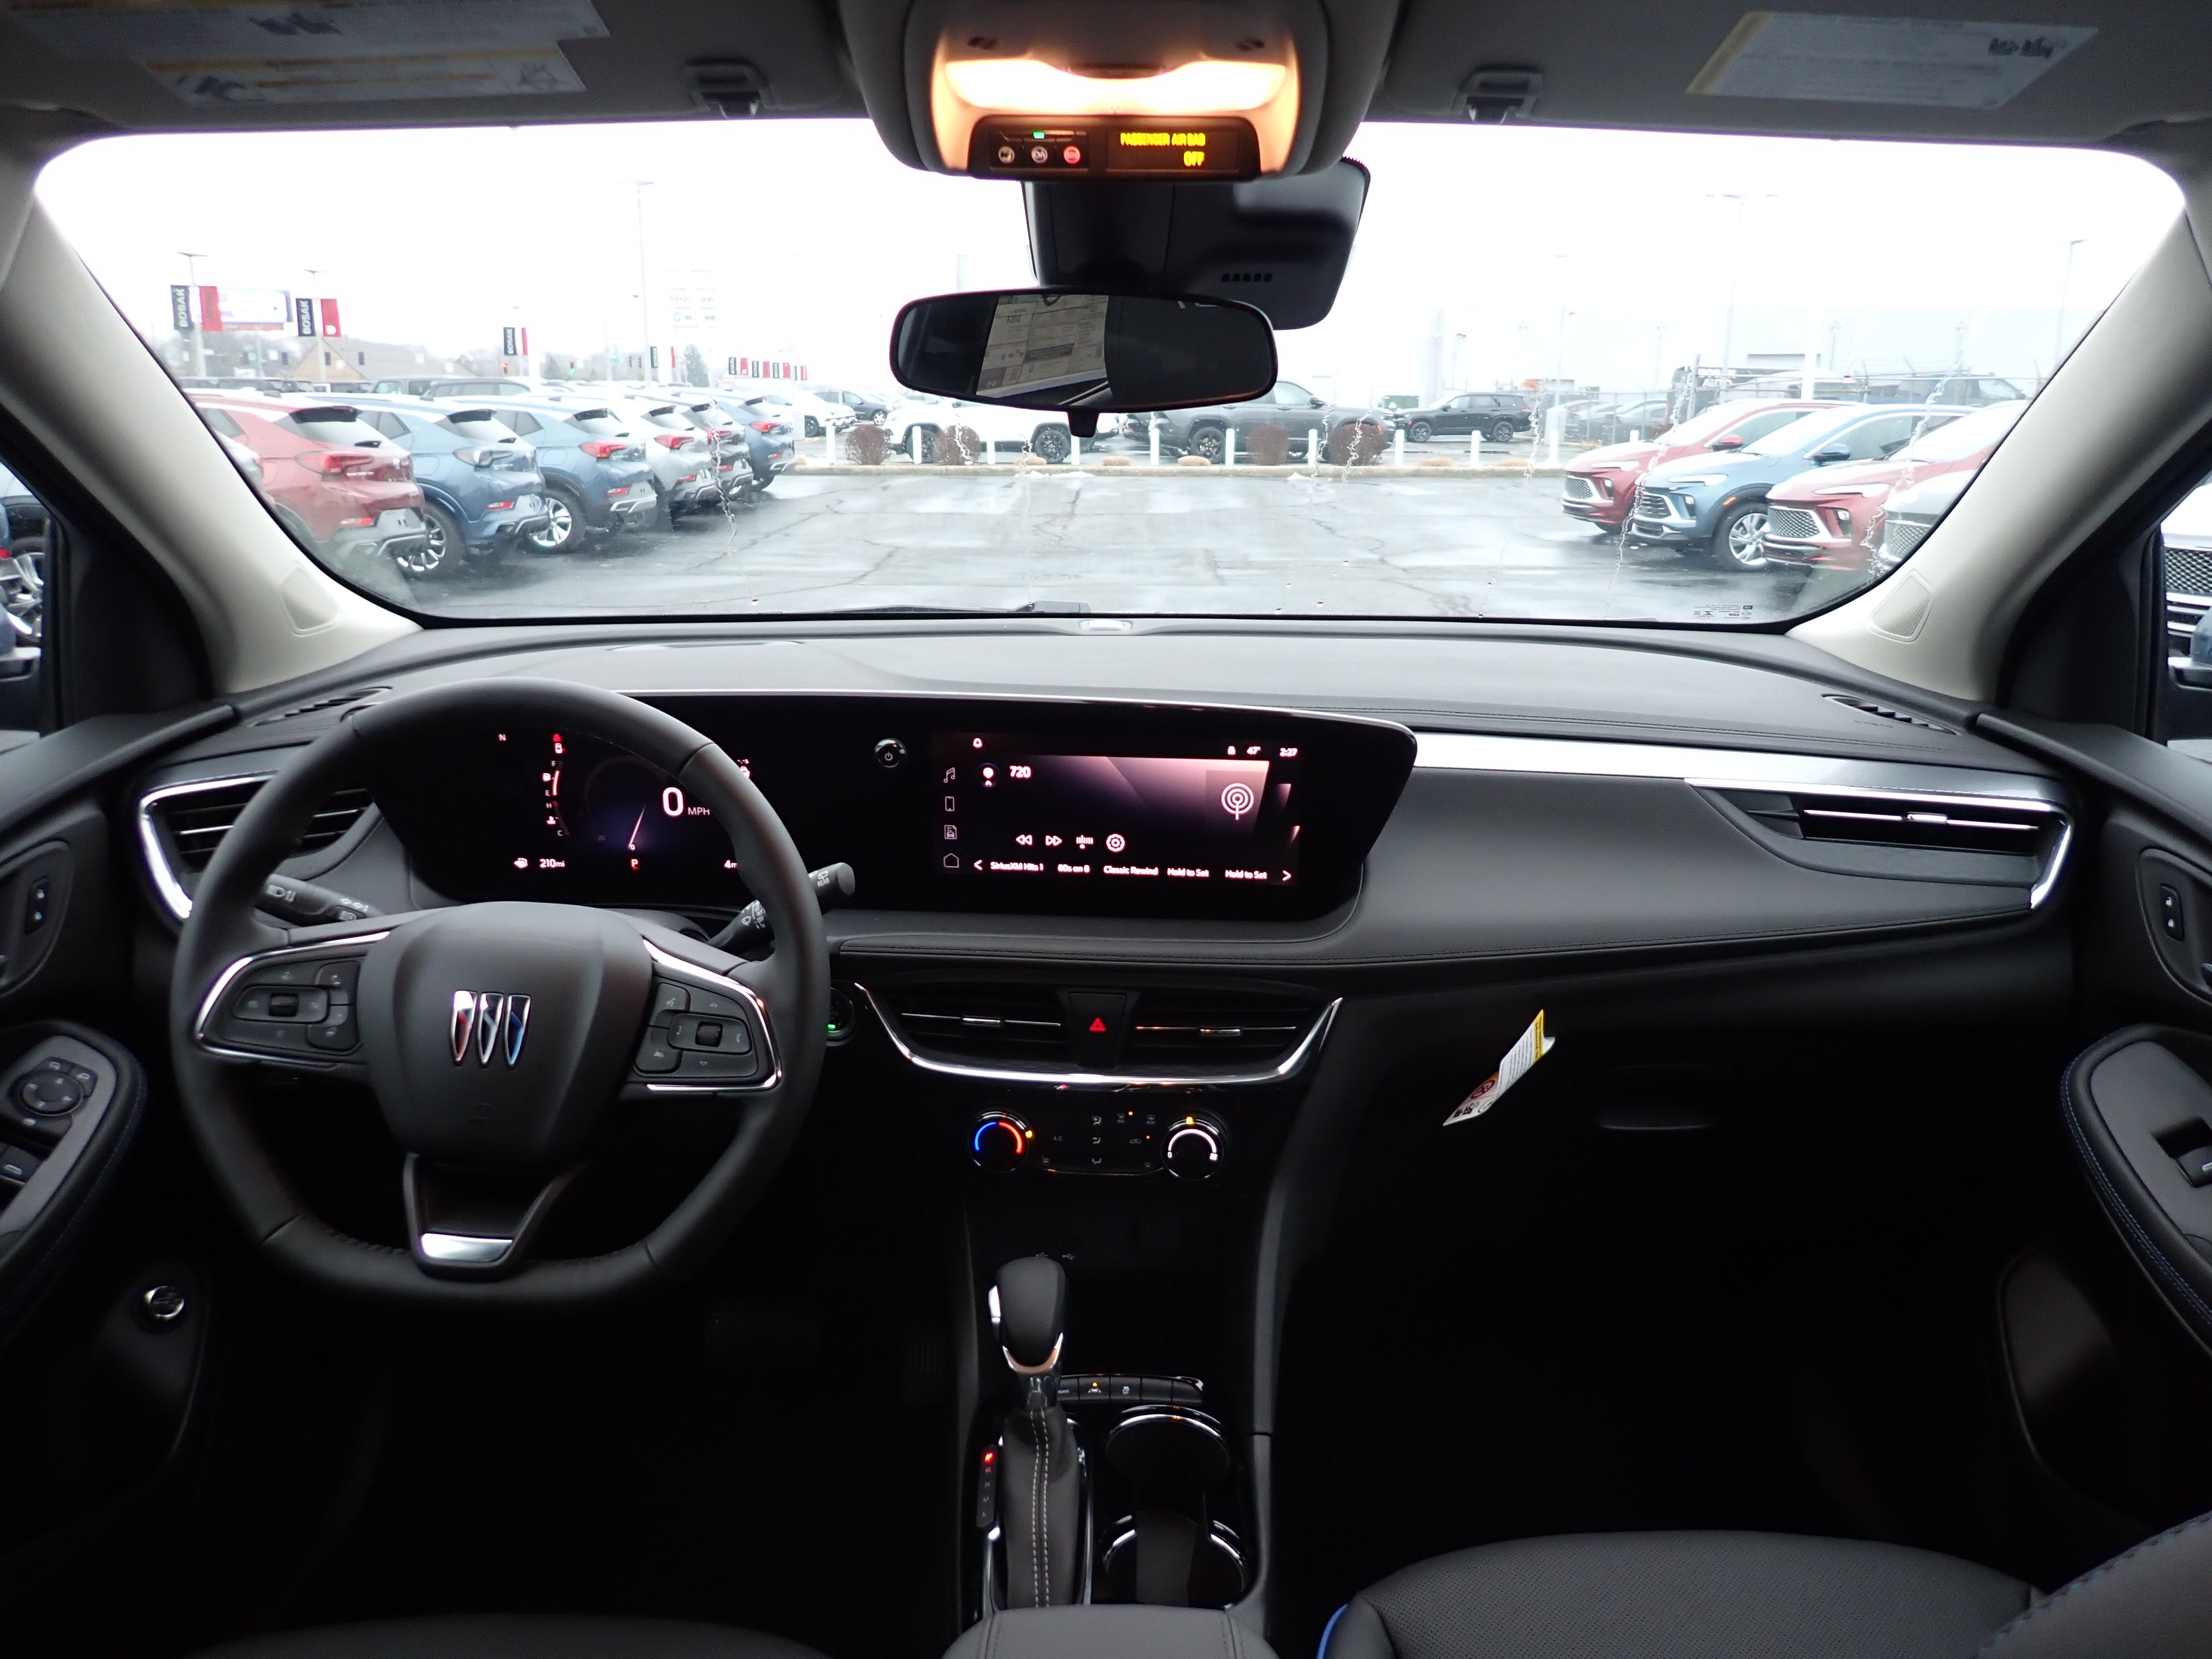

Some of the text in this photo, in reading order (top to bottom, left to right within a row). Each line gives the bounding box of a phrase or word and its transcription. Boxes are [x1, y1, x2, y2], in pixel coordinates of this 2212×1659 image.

[1120, 133, 1206, 147] PASSENGER AIR BAG
[1183, 151, 1205, 166] OFF
[173, 288, 188, 327] BOSAK
[299, 300, 312, 335] BOSAK
[1280, 748, 1298, 757] 2:27
[1010, 766, 1031, 778] 720
[662, 787, 711, 816] 0 MPH
[631, 859, 638, 868] P
[1023, 862, 1039, 871] Hits
[1103, 865, 1159, 875] Classic Rewind
[1167, 868, 1186, 877] Hold
[1196, 869, 1209, 877] Set
[1225, 869, 1244, 878] Hold
[1254, 870, 1267, 879] Set
